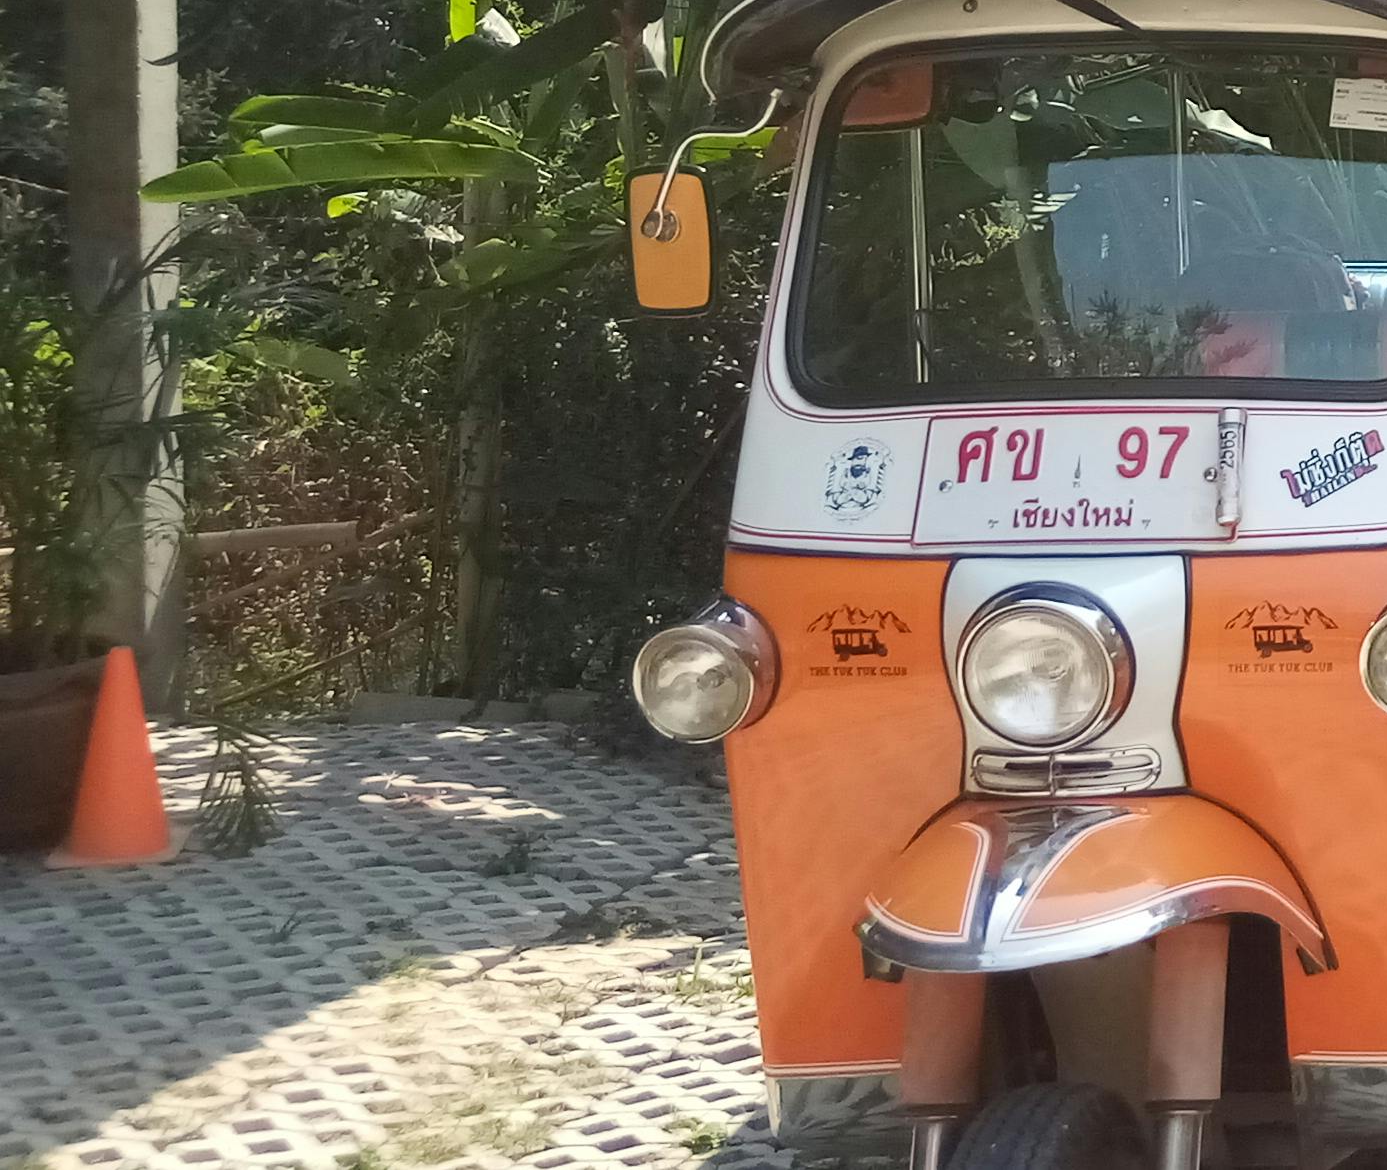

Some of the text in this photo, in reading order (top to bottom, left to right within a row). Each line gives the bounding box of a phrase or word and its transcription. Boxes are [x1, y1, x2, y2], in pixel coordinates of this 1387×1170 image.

[956, 425, 1191, 484] ศข 97
[1219, 430, 1238, 471] 2565
[1012, 497, 1134, 529] เชียงใหม่
[1227, 662, 1333, 673] THE TUK TUK CLUB
